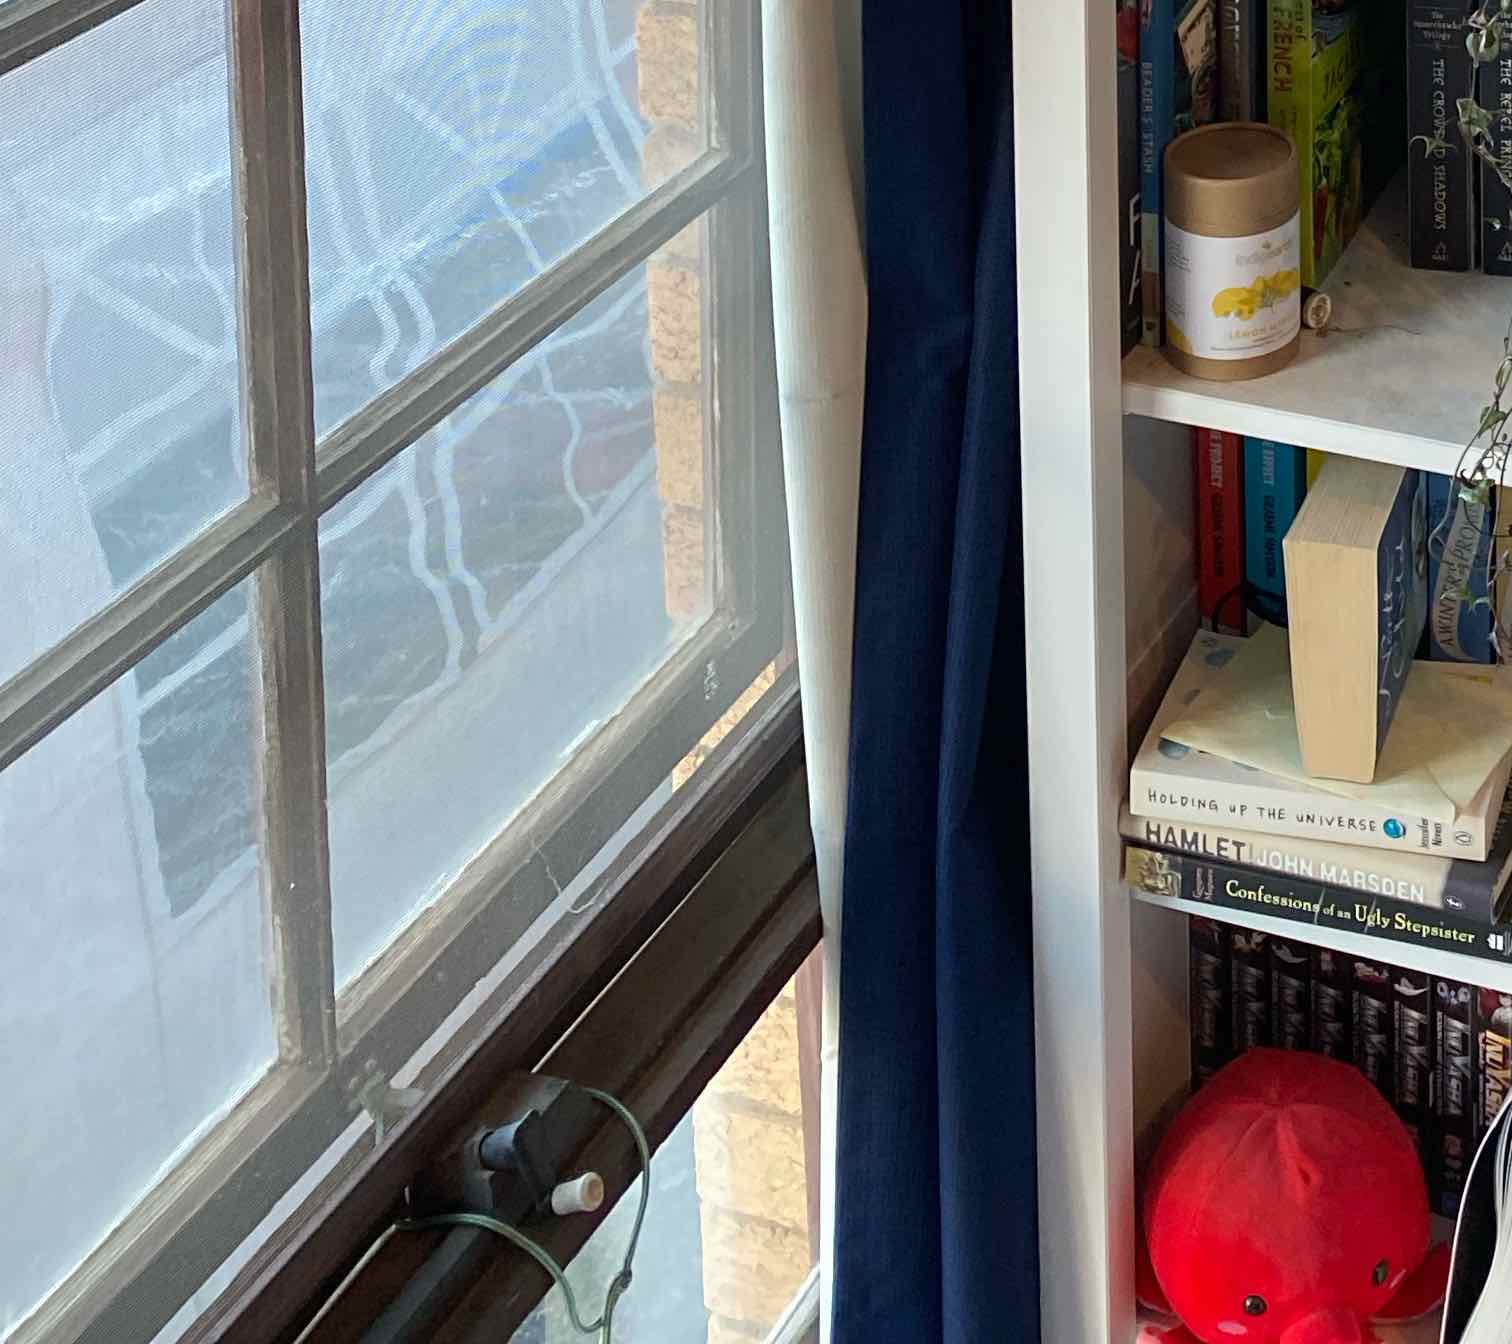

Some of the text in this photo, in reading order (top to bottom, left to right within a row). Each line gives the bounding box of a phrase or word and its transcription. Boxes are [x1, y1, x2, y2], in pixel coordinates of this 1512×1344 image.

[1273, 6, 1295, 94] FRENCH
[1499, 59, 1512, 86] THE
[1142, 131, 1153, 175] STASH
[1432, 59, 1447, 232] THE CROWDD SHADOWS
[1146, 788, 1378, 834] HOLDING UP THE UNIVERSE
[1145, 821, 1425, 904] HAMLET JOHN MARSDEN
[1224, 878, 1476, 946] Confessions of an Ugly Stepsister
